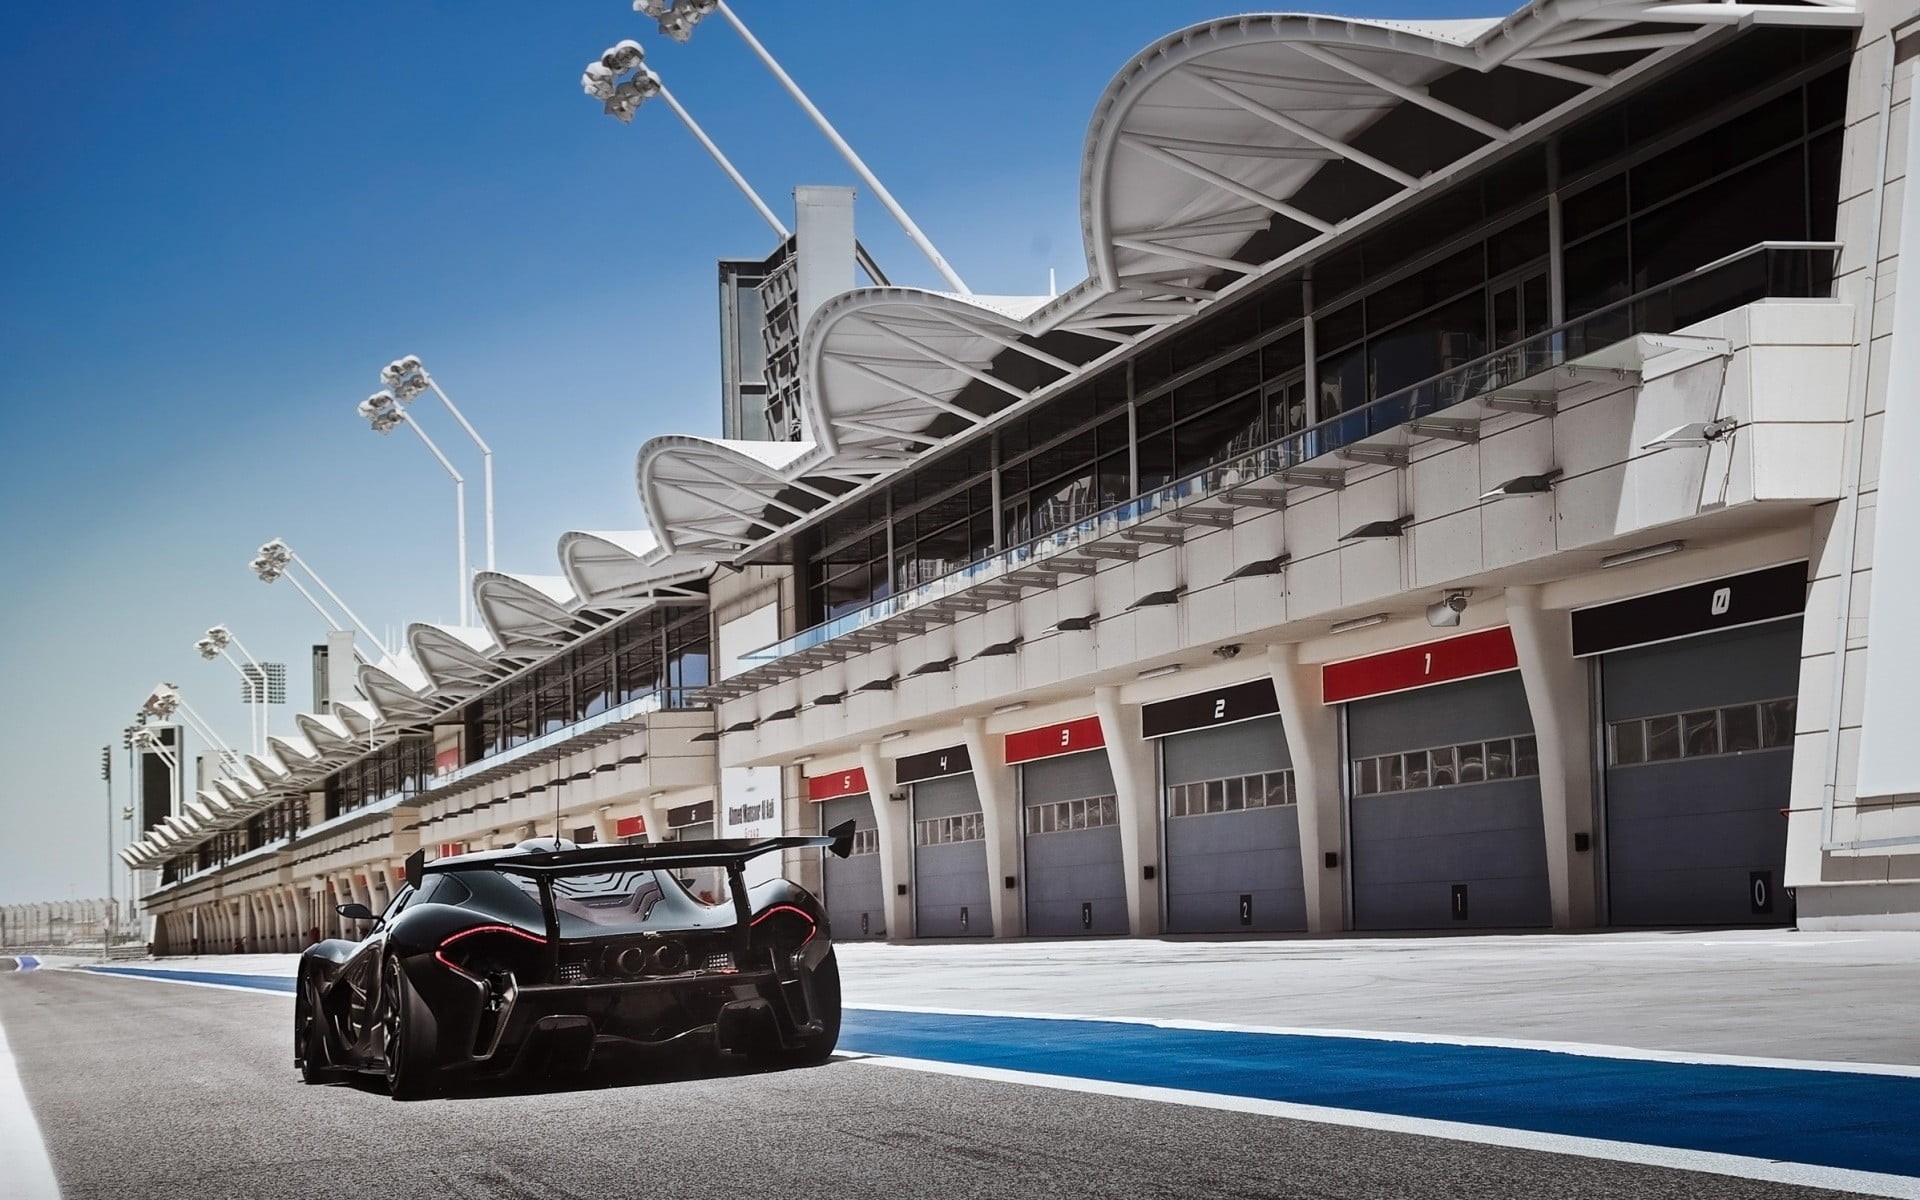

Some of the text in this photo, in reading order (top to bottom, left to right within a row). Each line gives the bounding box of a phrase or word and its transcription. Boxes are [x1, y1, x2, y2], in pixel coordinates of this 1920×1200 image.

[1711, 587, 1731, 616] 0
[1424, 652, 1432, 675] 1
[1214, 699, 1226, 719] 2
[1060, 729, 1070, 746] 3
[940, 755, 948, 771] 4
[843, 775, 851, 789] 5
[1456, 892, 1462, 912] 1
[1754, 879, 1766, 907] 0
[1242, 901, 1248, 919] 2
